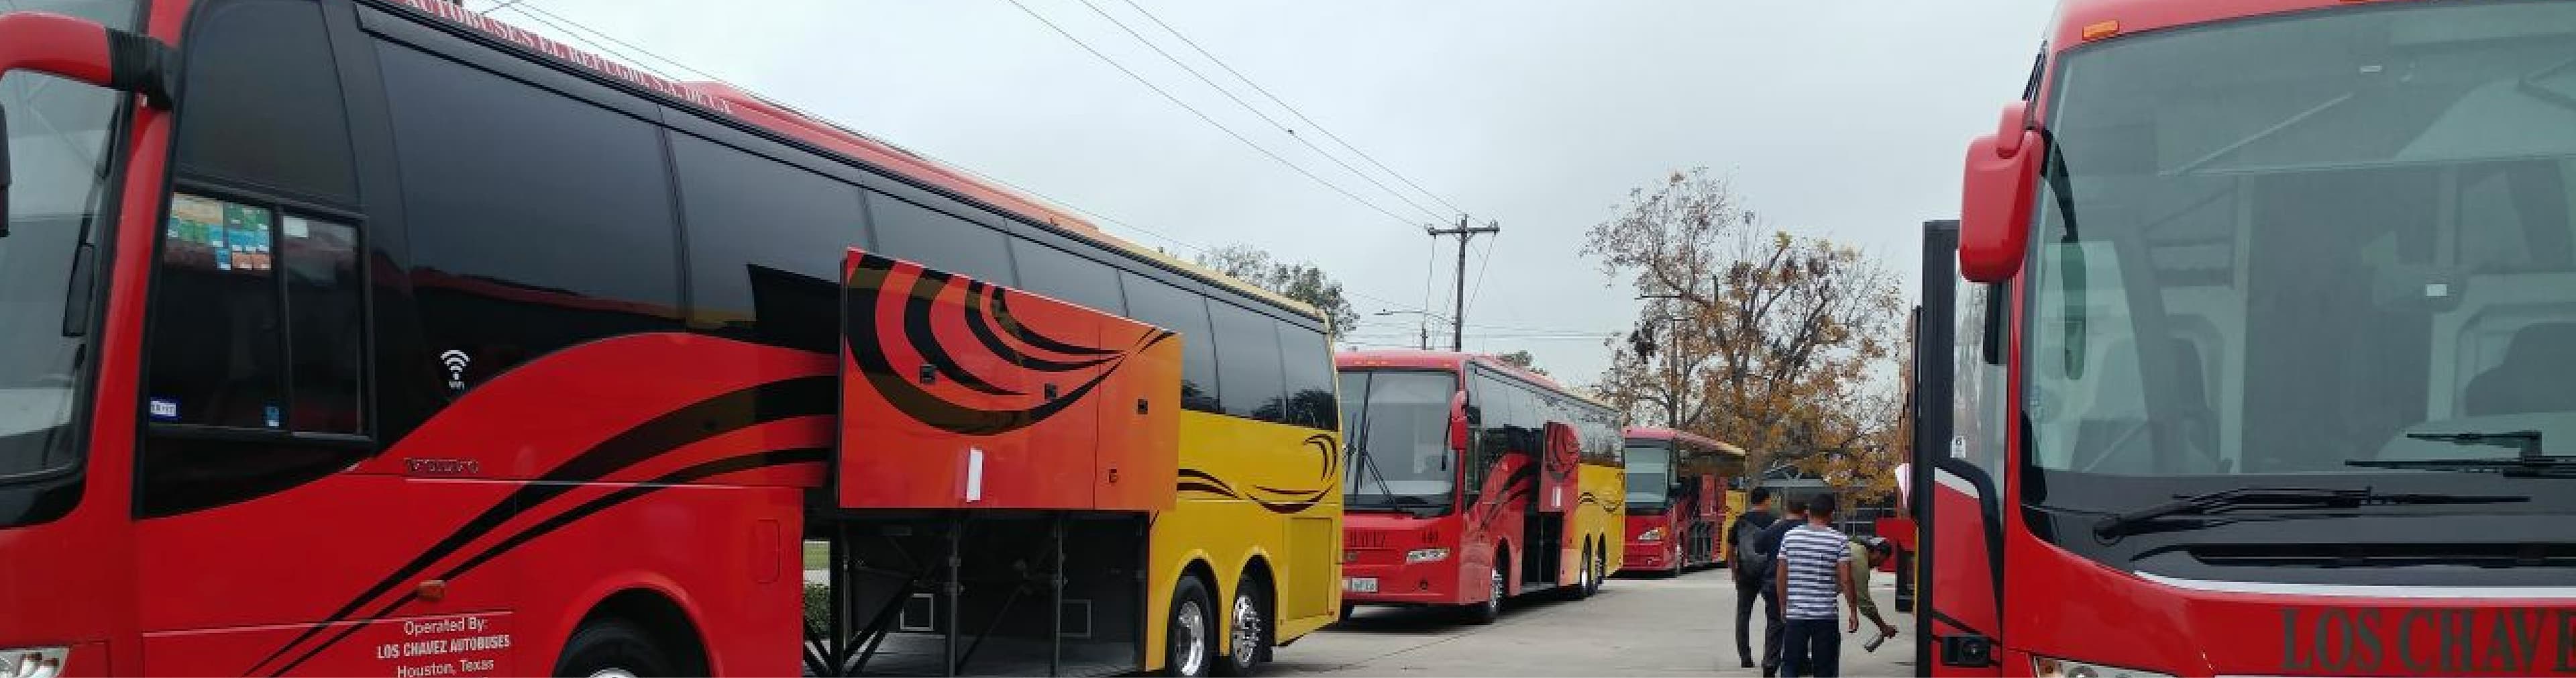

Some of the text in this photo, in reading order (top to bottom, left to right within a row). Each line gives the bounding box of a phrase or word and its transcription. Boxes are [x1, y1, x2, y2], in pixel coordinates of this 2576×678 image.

[404, 617, 465, 636] Operated
[377, 634, 511, 659] LOS CHAVEZ AUTOBUSES
[2281, 607, 2384, 671] LOS
[397, 659, 494, 678] Houston, Texas
